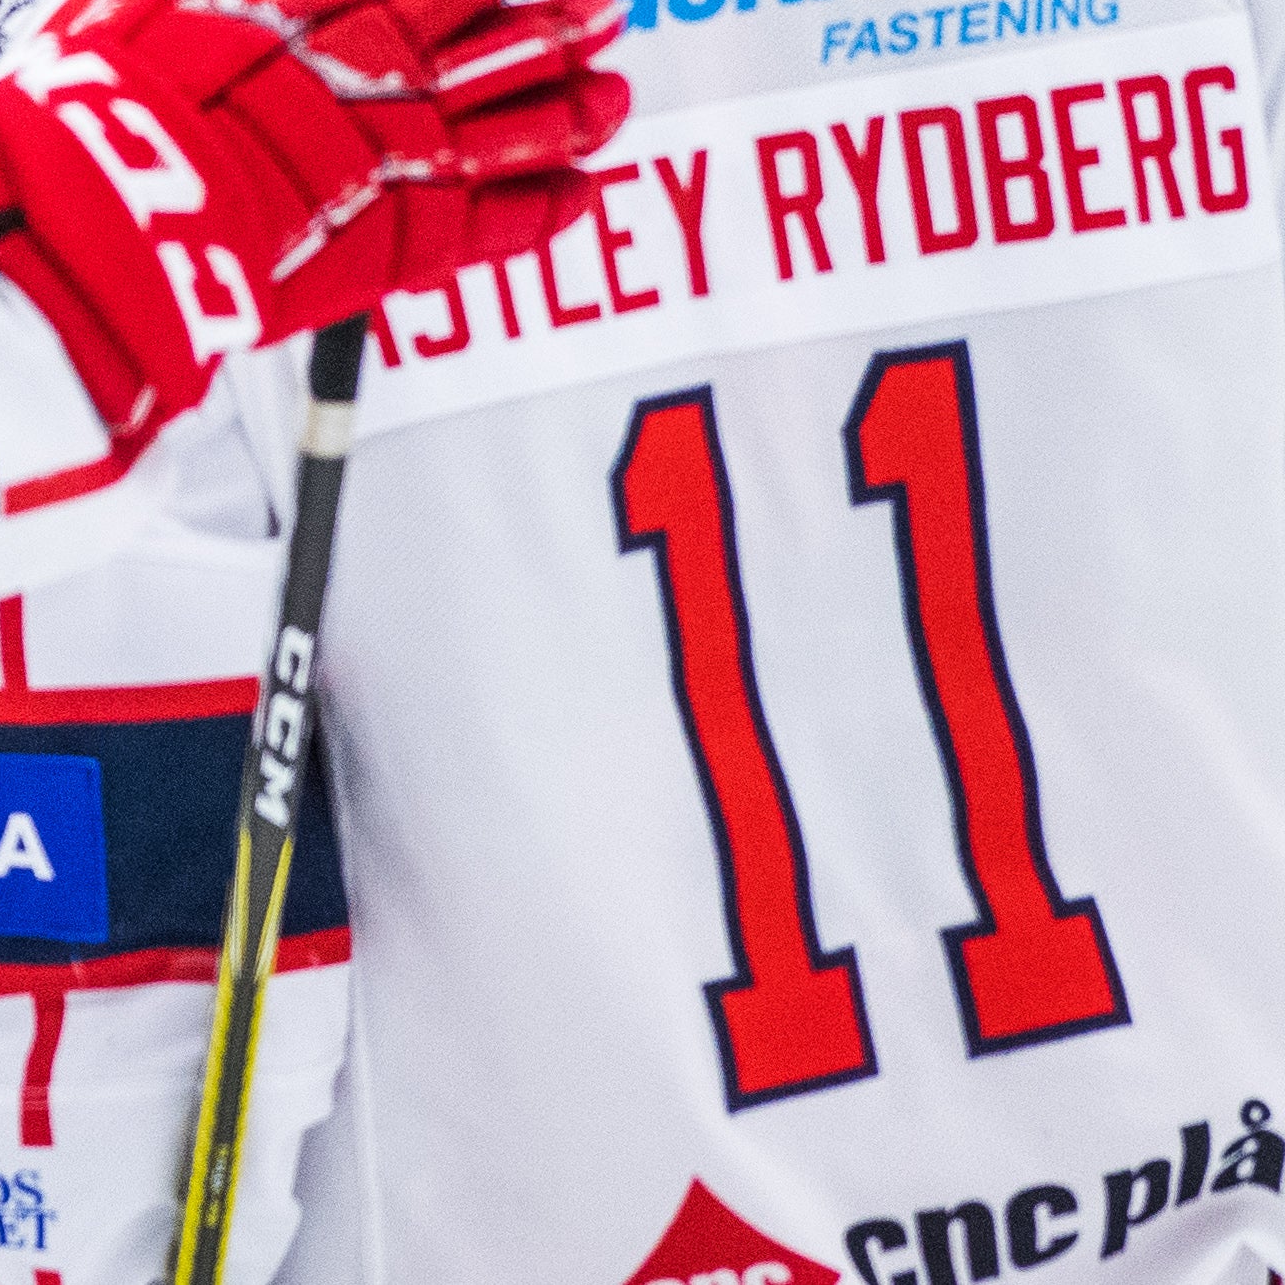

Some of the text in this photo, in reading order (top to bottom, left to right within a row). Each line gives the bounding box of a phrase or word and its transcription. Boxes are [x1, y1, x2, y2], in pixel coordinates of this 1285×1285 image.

[754, 64, 1250, 283] RYDBERG
[255, 625, 316, 829] CCM
[607, 338, 1133, 1115] 11
[842, 1183, 1079, 1285] cnc
